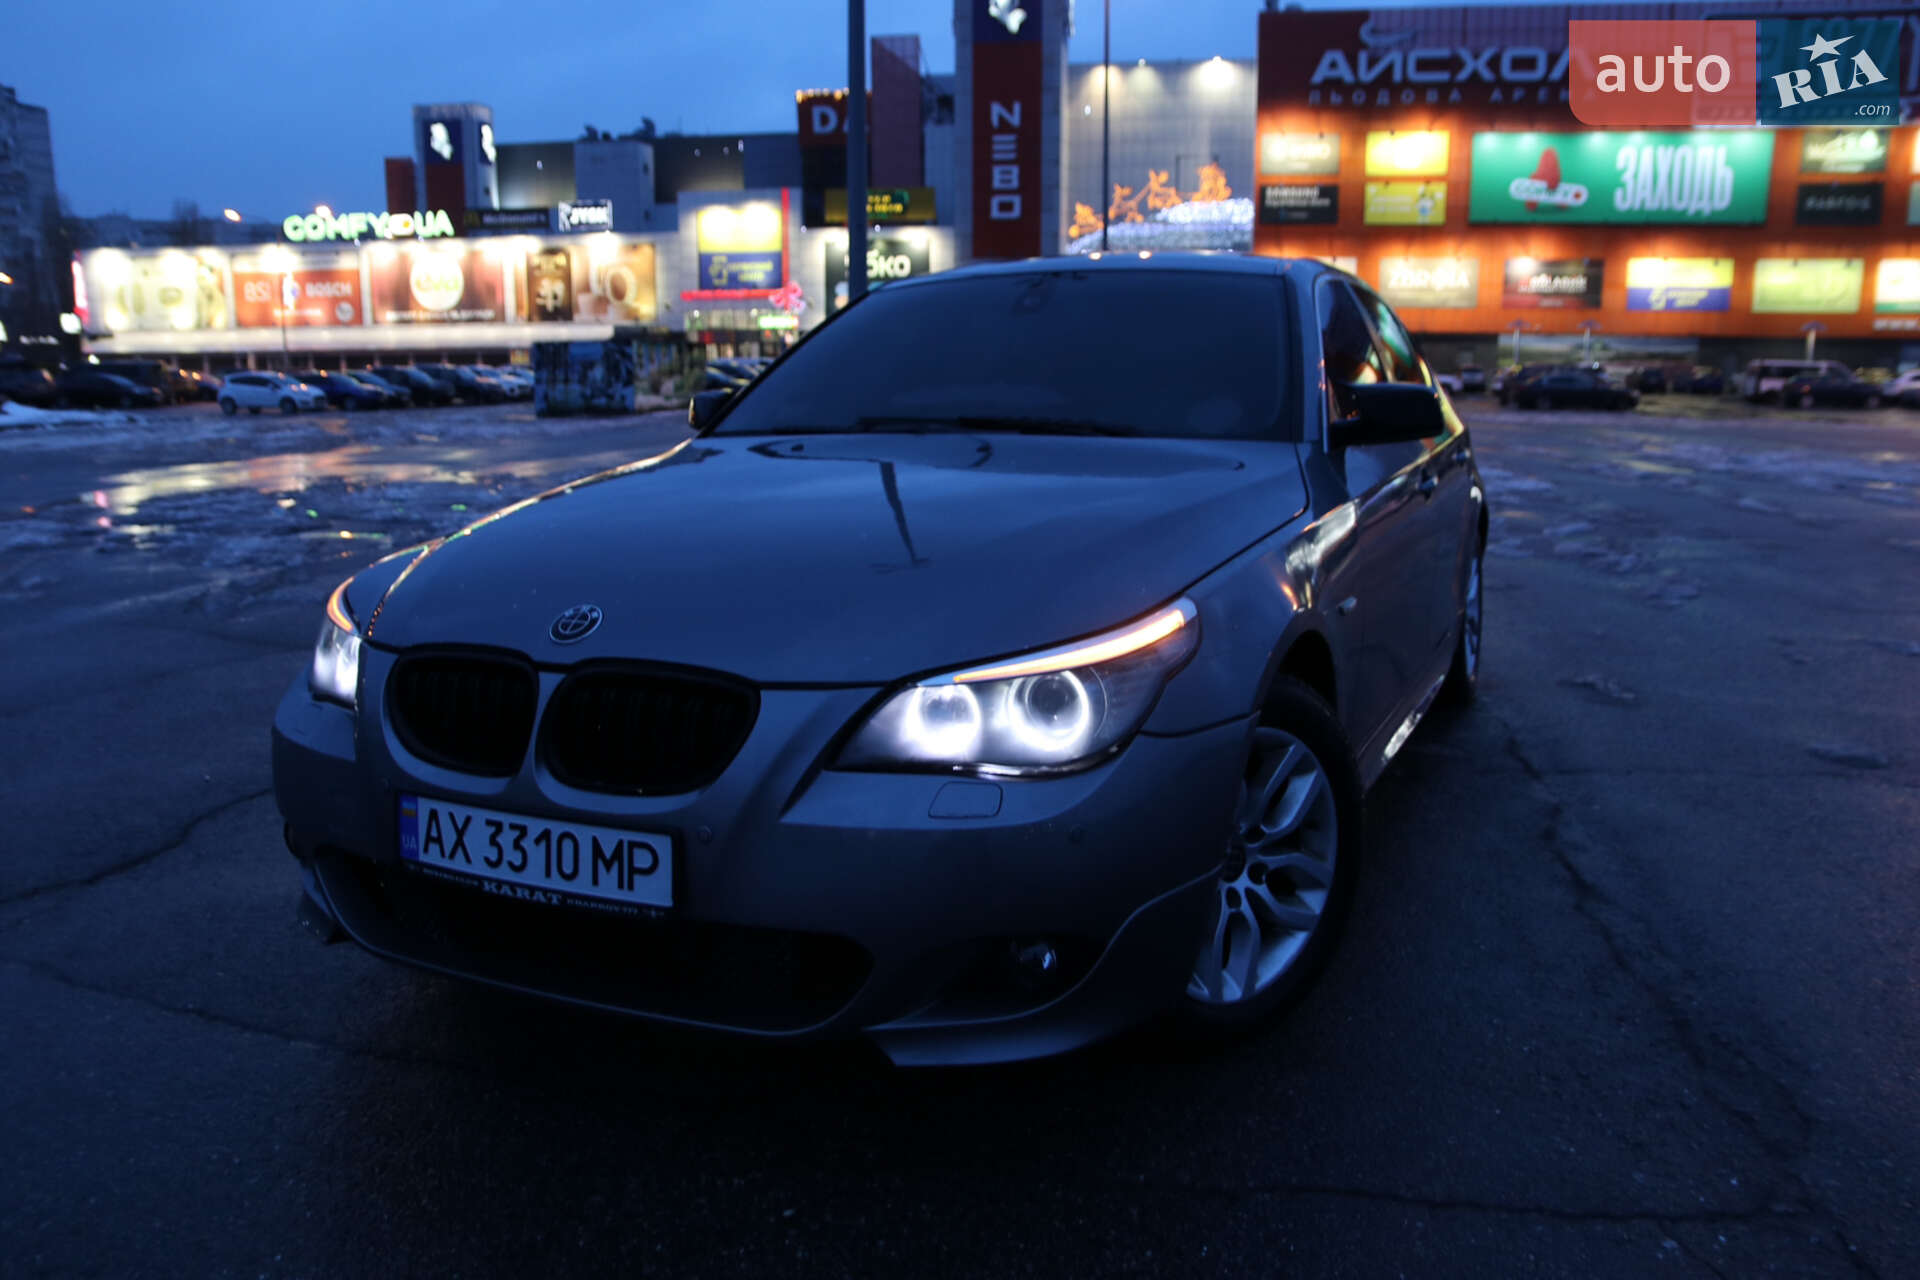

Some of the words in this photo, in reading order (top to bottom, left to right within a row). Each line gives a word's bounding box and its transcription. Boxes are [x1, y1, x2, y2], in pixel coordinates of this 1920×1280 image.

[1613, 144, 1735, 217] ЗАХОДЬ
[422, 807, 473, 865] AX
[482, 818, 580, 882] 3310
[590, 834, 660, 892] MP
[481, 880, 563, 906] KARAT
